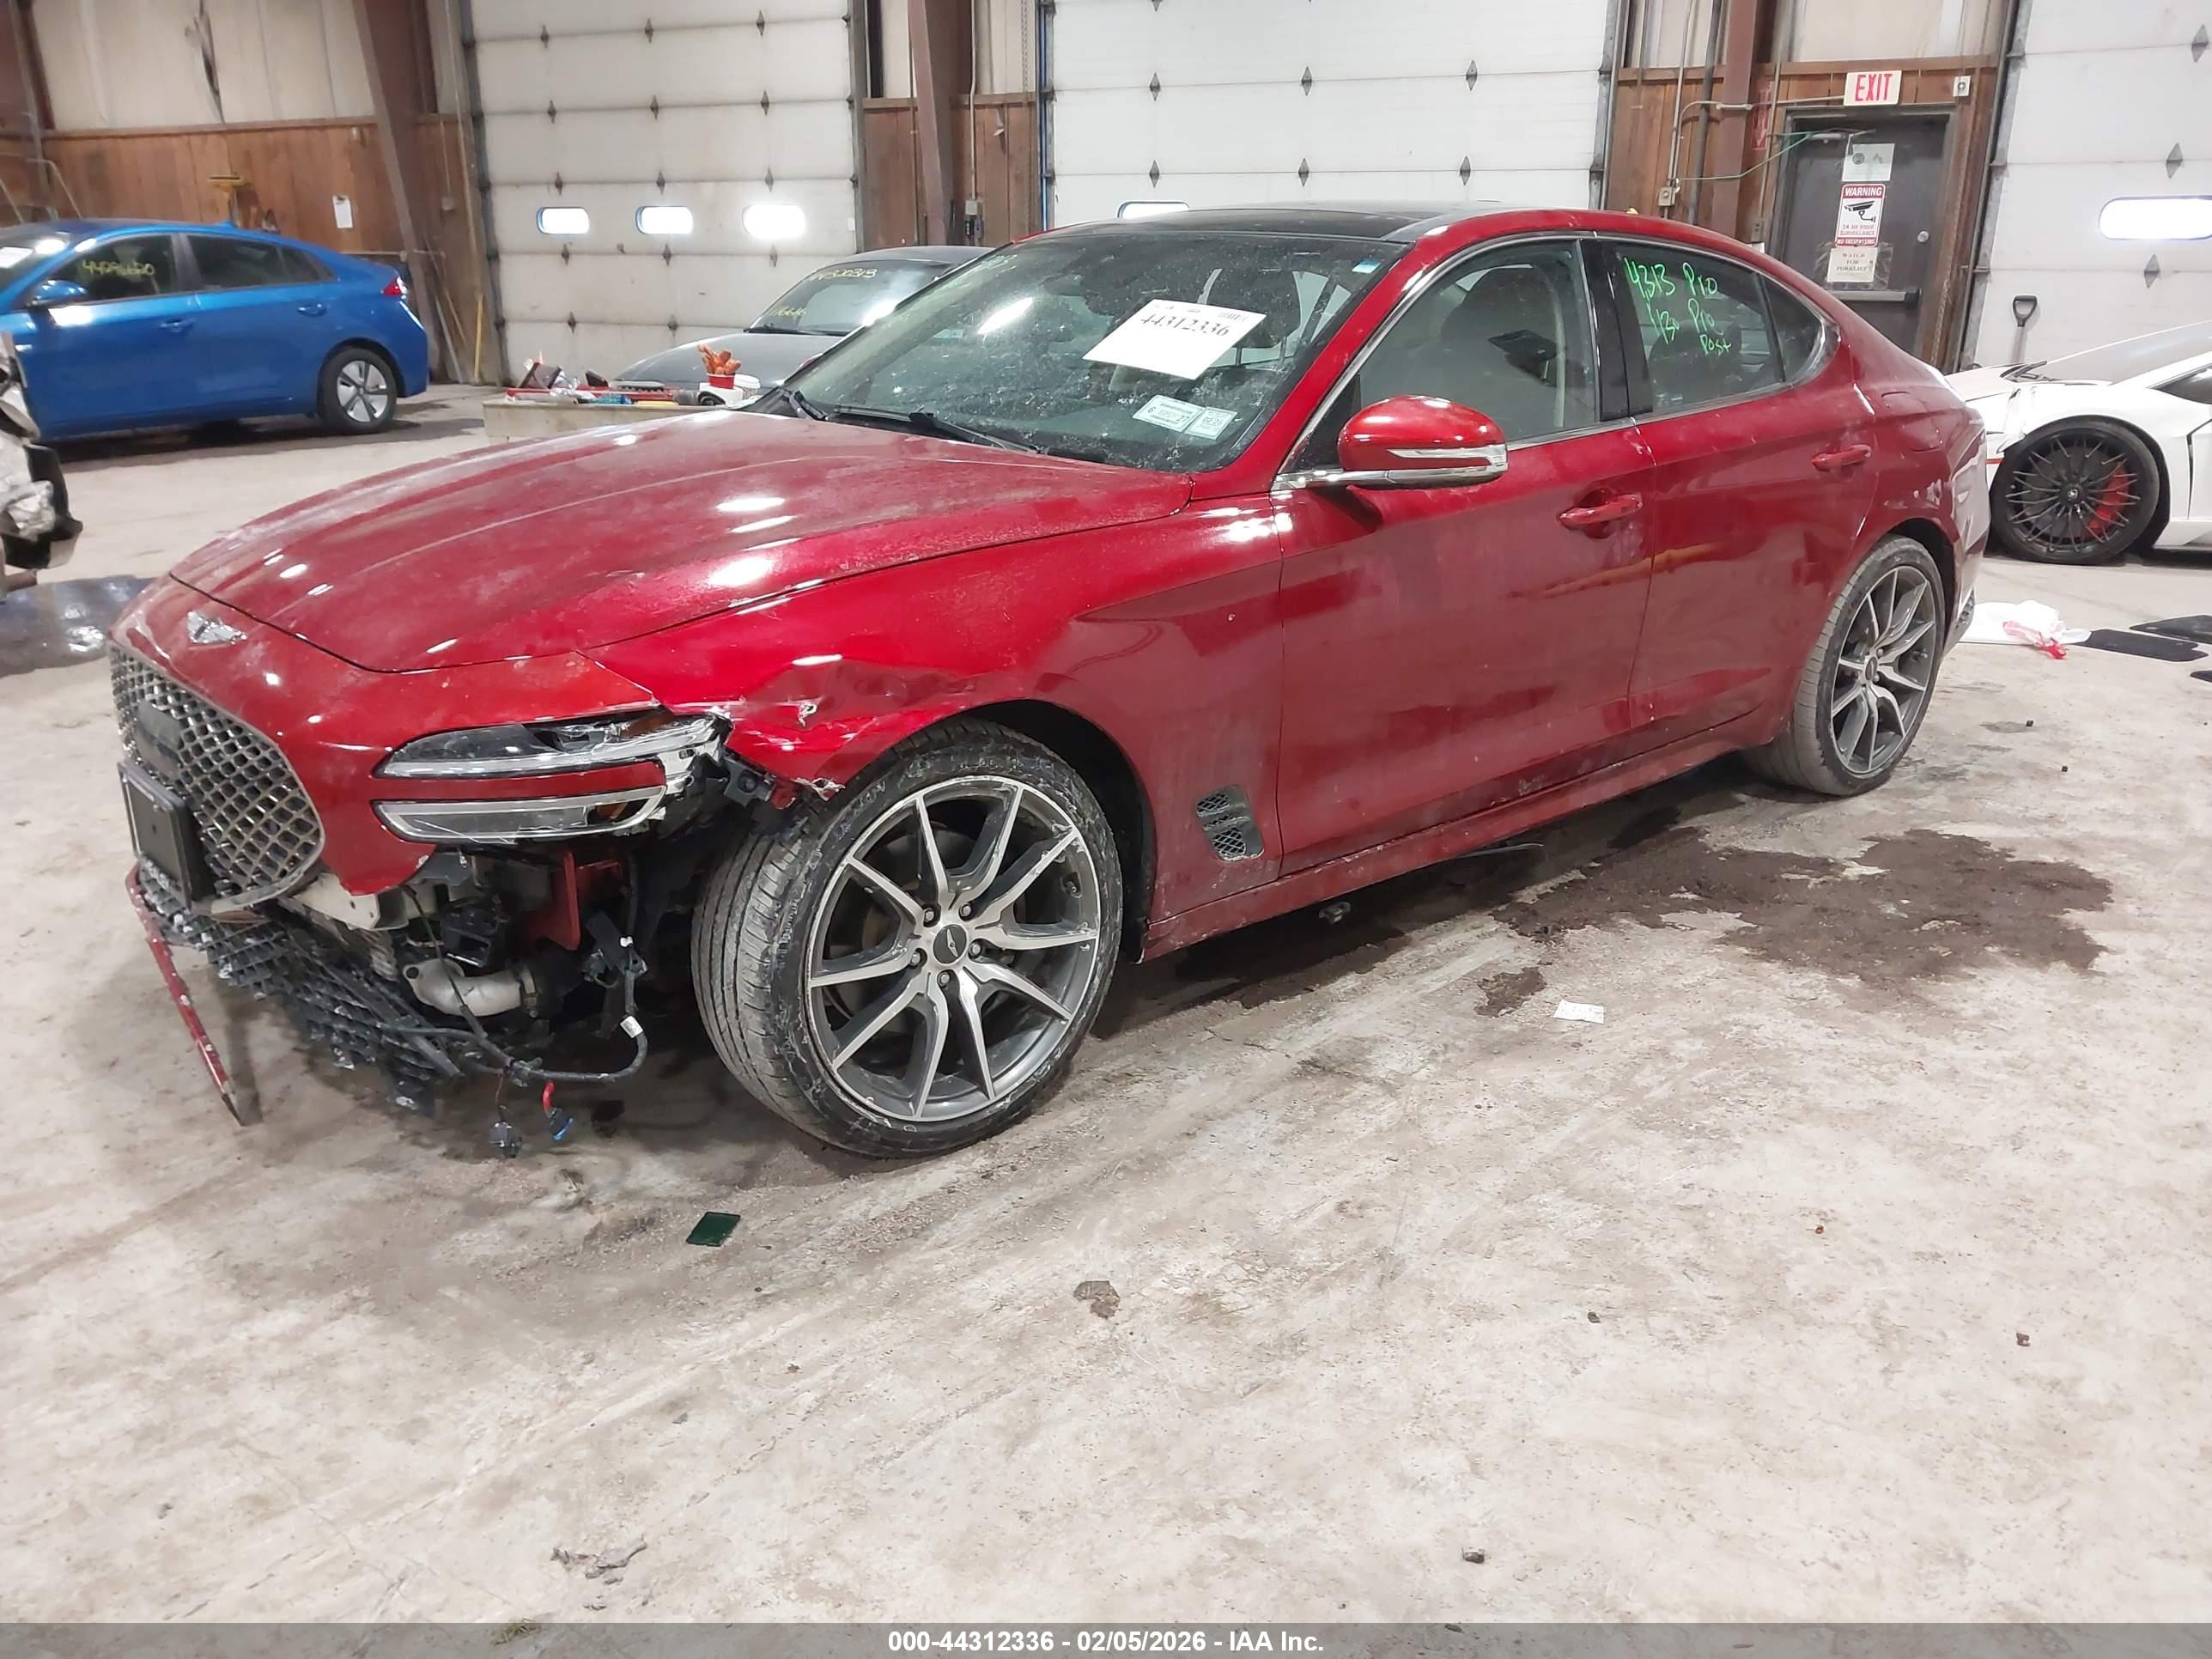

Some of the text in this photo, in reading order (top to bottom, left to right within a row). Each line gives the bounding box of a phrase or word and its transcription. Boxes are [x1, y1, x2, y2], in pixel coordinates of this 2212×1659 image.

[1855, 74, 1893, 101] EXIT
[1844, 186, 1882, 197] WARNING
[1140, 313, 1230, 337] 44312336
